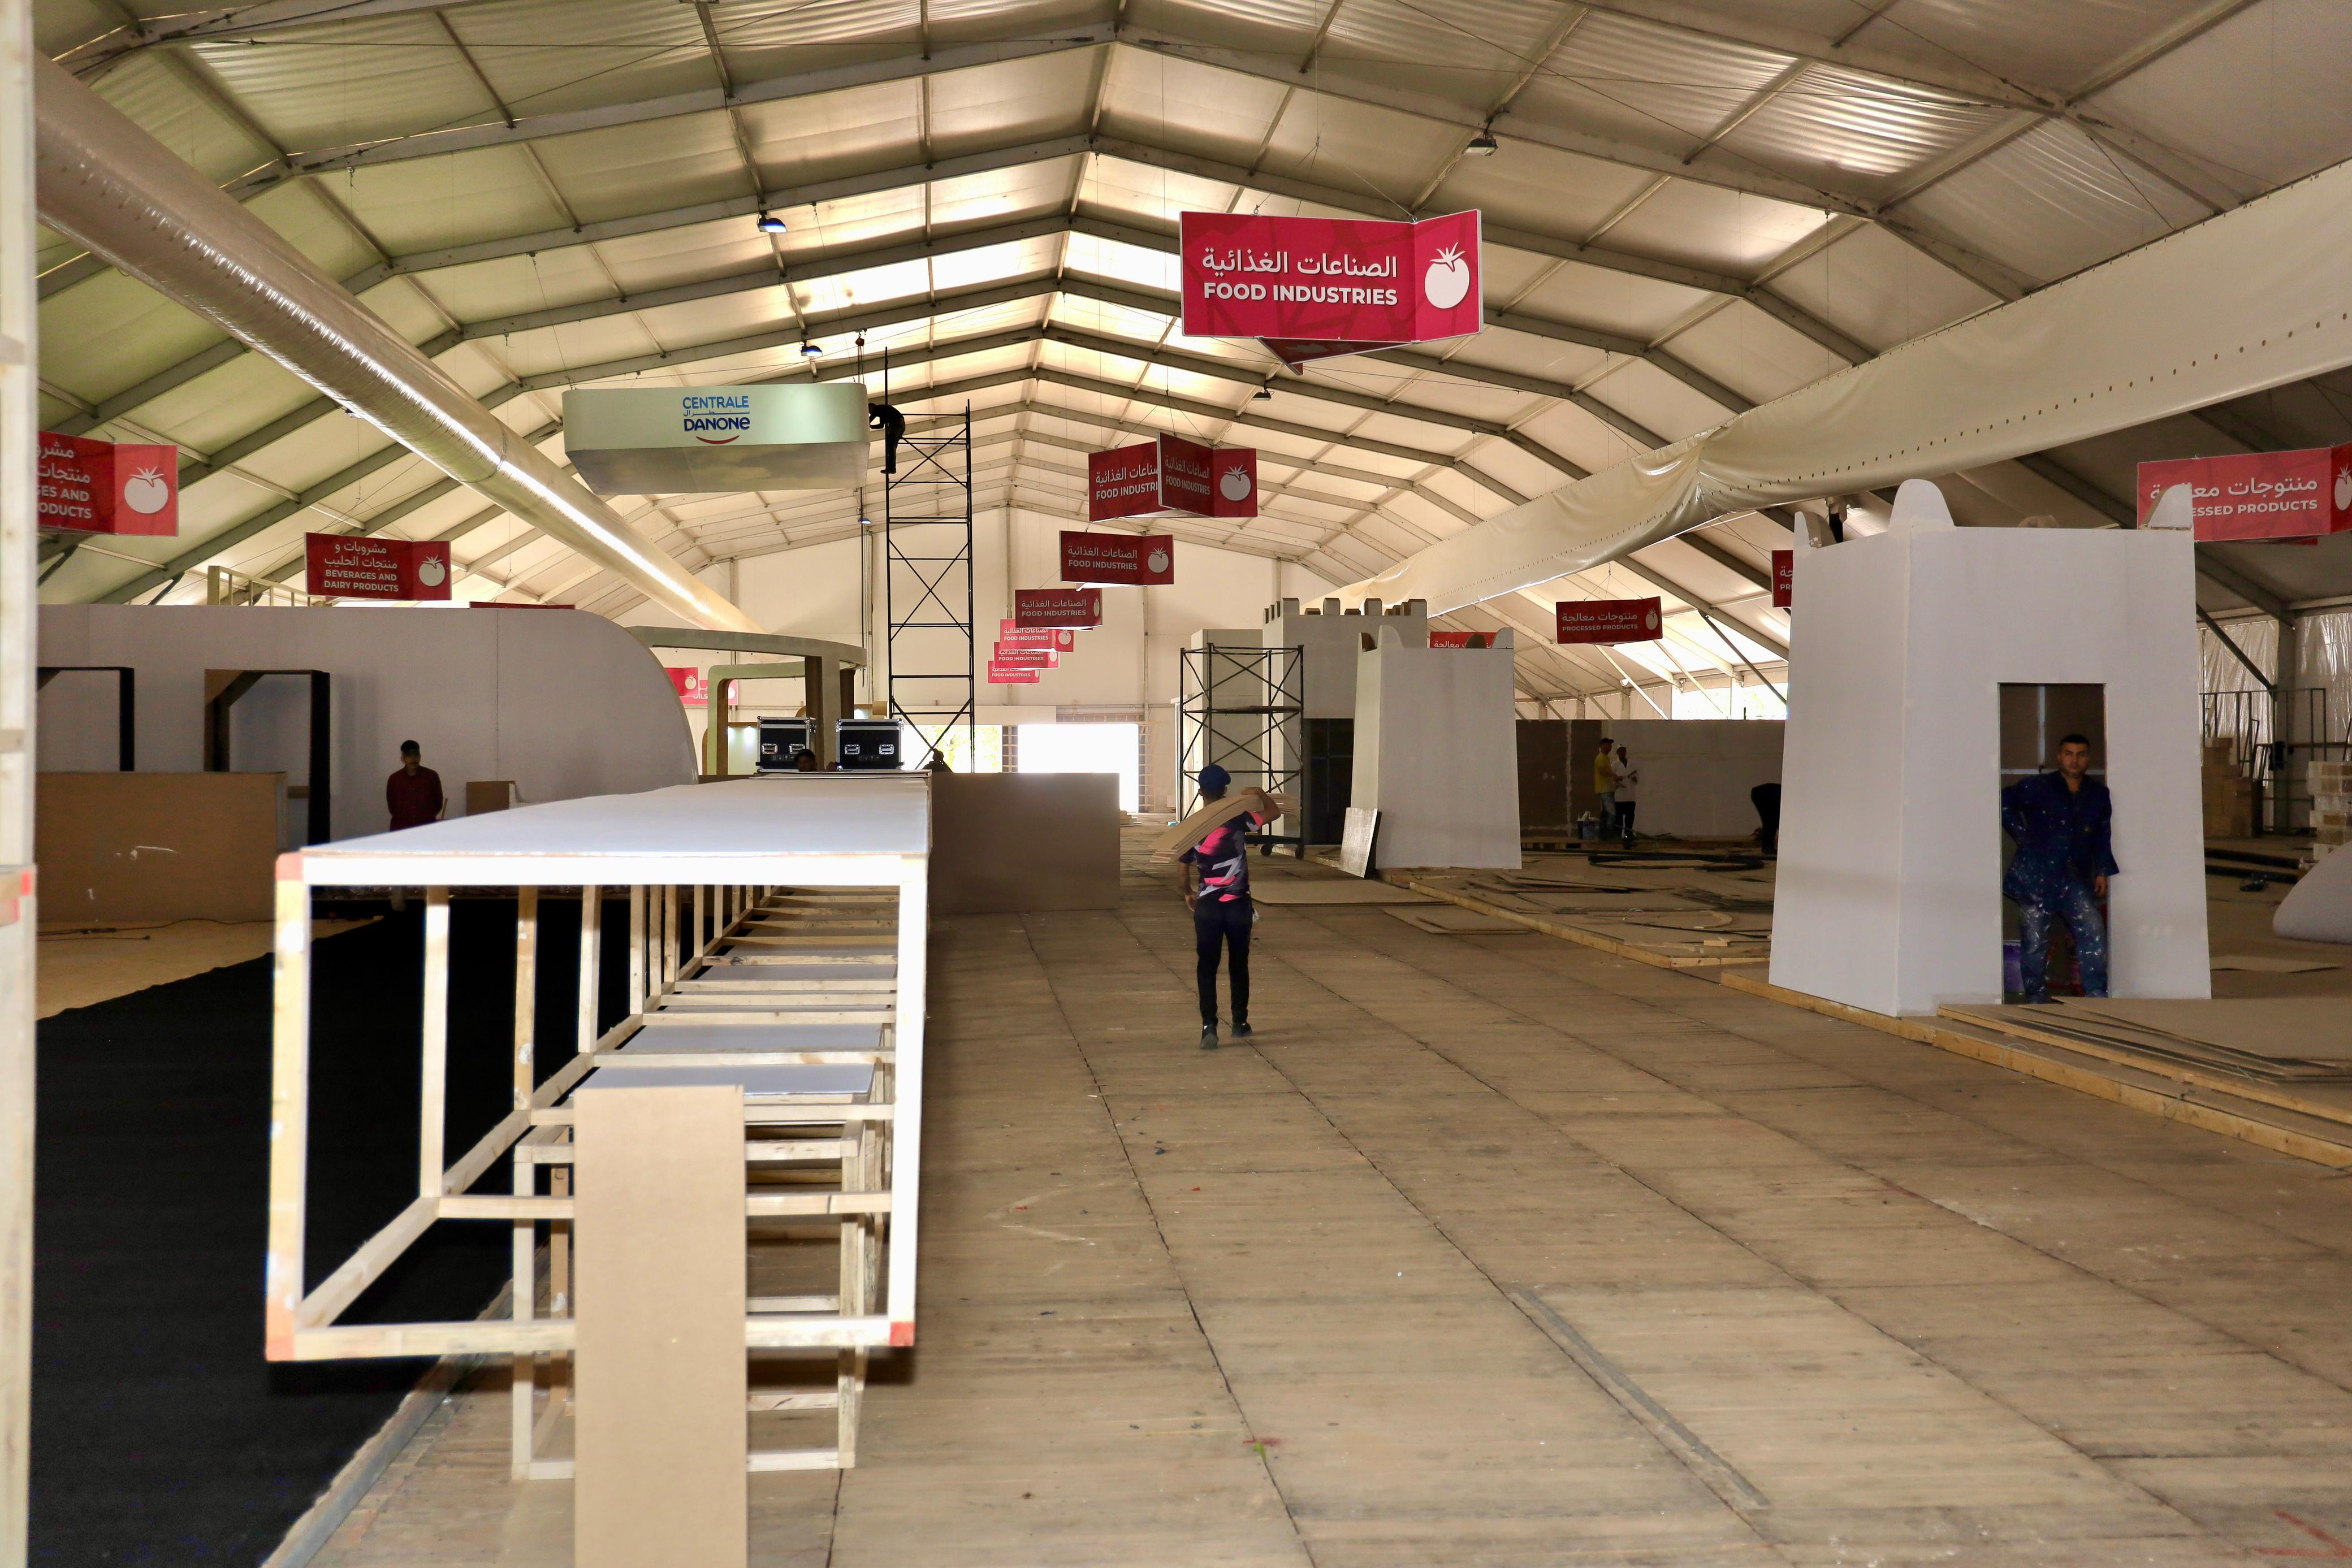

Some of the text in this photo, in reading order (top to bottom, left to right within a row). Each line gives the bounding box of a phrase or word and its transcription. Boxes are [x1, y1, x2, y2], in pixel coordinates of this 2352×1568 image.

[1203, 247, 1396, 278] الصناعات الغذائية
[1204, 282, 1398, 305] FOOD INDUSTRIES
[682, 396, 749, 409] CENTRALE
[1165, 454, 1210, 479] الصناعات الغذائية
[1096, 463, 1158, 487] ناعات الغذائية
[1096, 481, 1158, 500] FOOD INDUSTRI
[1166, 475, 1210, 495] FOOD INDUSTRIES
[2228, 477, 2318, 498] منتوجات
[60, 488, 90, 502] AND
[37, 502, 92, 519] ODUCTS
[2238, 500, 2318, 514] PRODUCTS
[335, 541, 387, 556] مشروبات و
[1068, 545, 1138, 559] الصناعات الغذائية
[325, 555, 397, 570] منتجات الحليب
[1093, 561, 1138, 570] INDUSTRIES
[326, 569, 377, 580] BEVERAGES
[324, 580, 399, 592] DAIRY PRODUCTS
[1022, 599, 1050, 610] الغذائية
[1562, 612, 1637, 623] منتوجات معالجة
